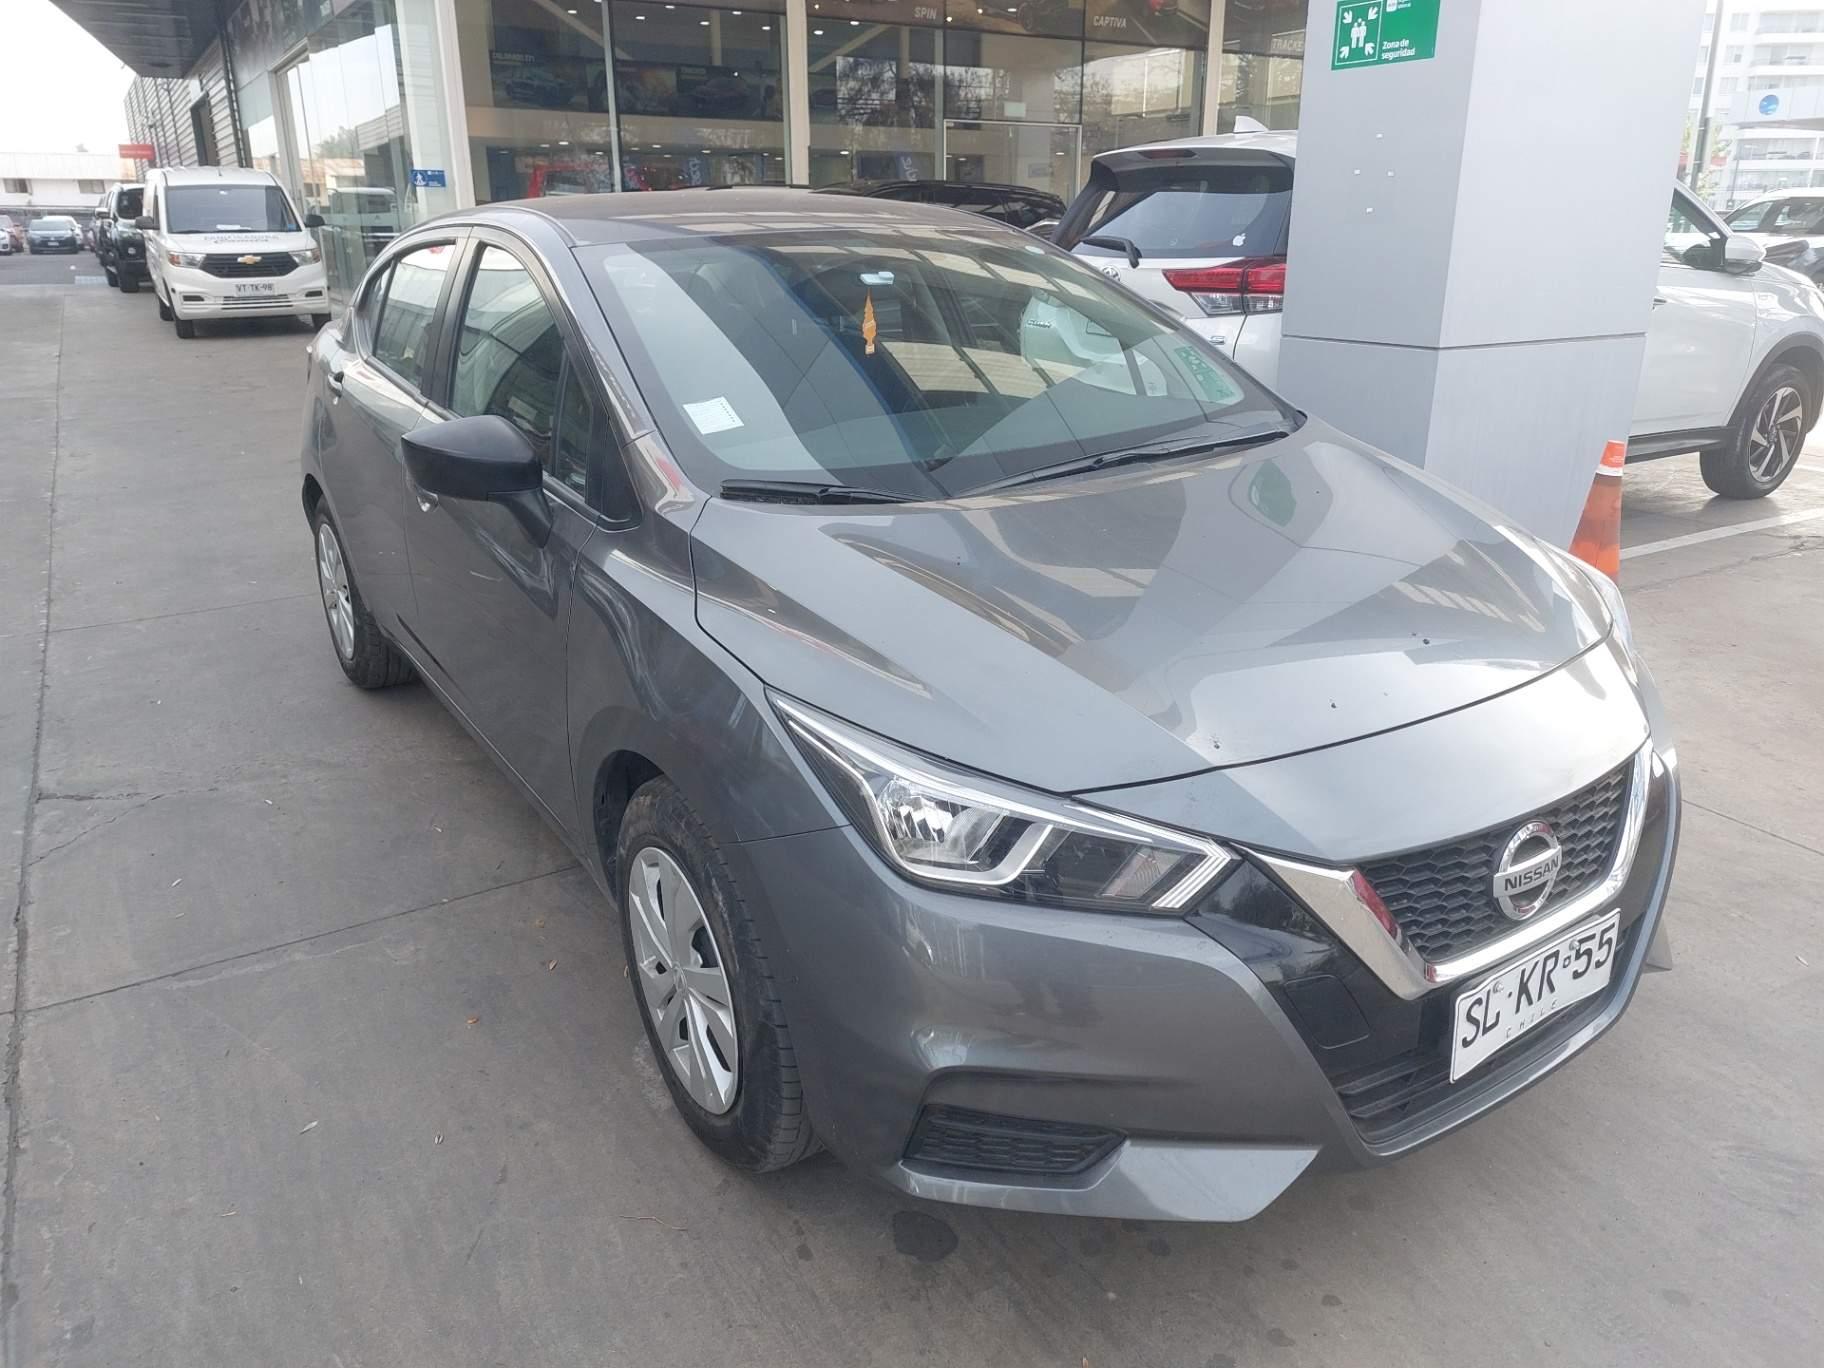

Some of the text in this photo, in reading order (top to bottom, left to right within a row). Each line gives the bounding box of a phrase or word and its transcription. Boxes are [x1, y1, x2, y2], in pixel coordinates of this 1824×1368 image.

[914, 6, 937, 20] SPIN
[1093, 15, 1127, 29] CAPTIVA
[1382, 39, 1410, 49] Zona de
[1381, 47, 1416, 61] seguridad
[1504, 855, 1560, 891] NISSAN
